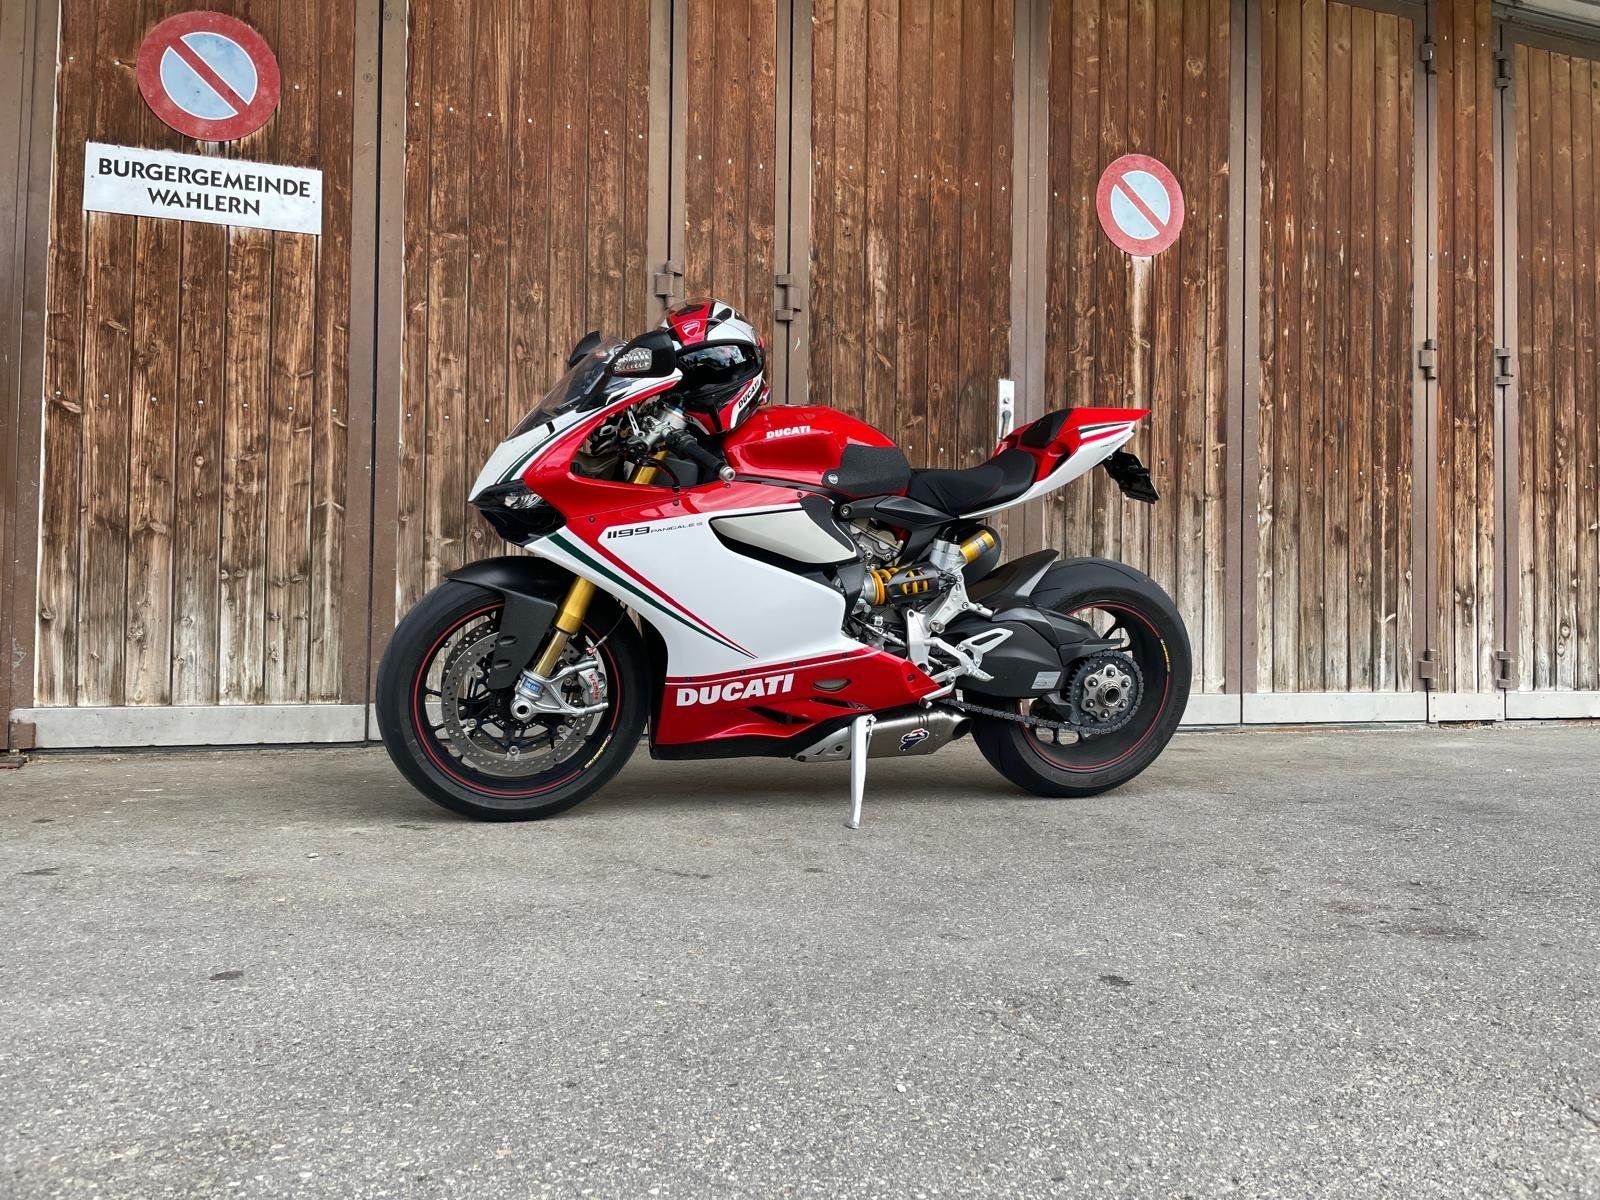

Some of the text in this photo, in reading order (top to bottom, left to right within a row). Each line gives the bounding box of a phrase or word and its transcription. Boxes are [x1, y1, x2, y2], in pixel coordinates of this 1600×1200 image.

[98, 157, 311, 198] BURGERGEMEINDE
[147, 187, 261, 216] WAHLERN
[766, 425, 811, 440] DUCATI
[607, 526, 651, 539] 1199
[676, 673, 795, 707] DUCATI
